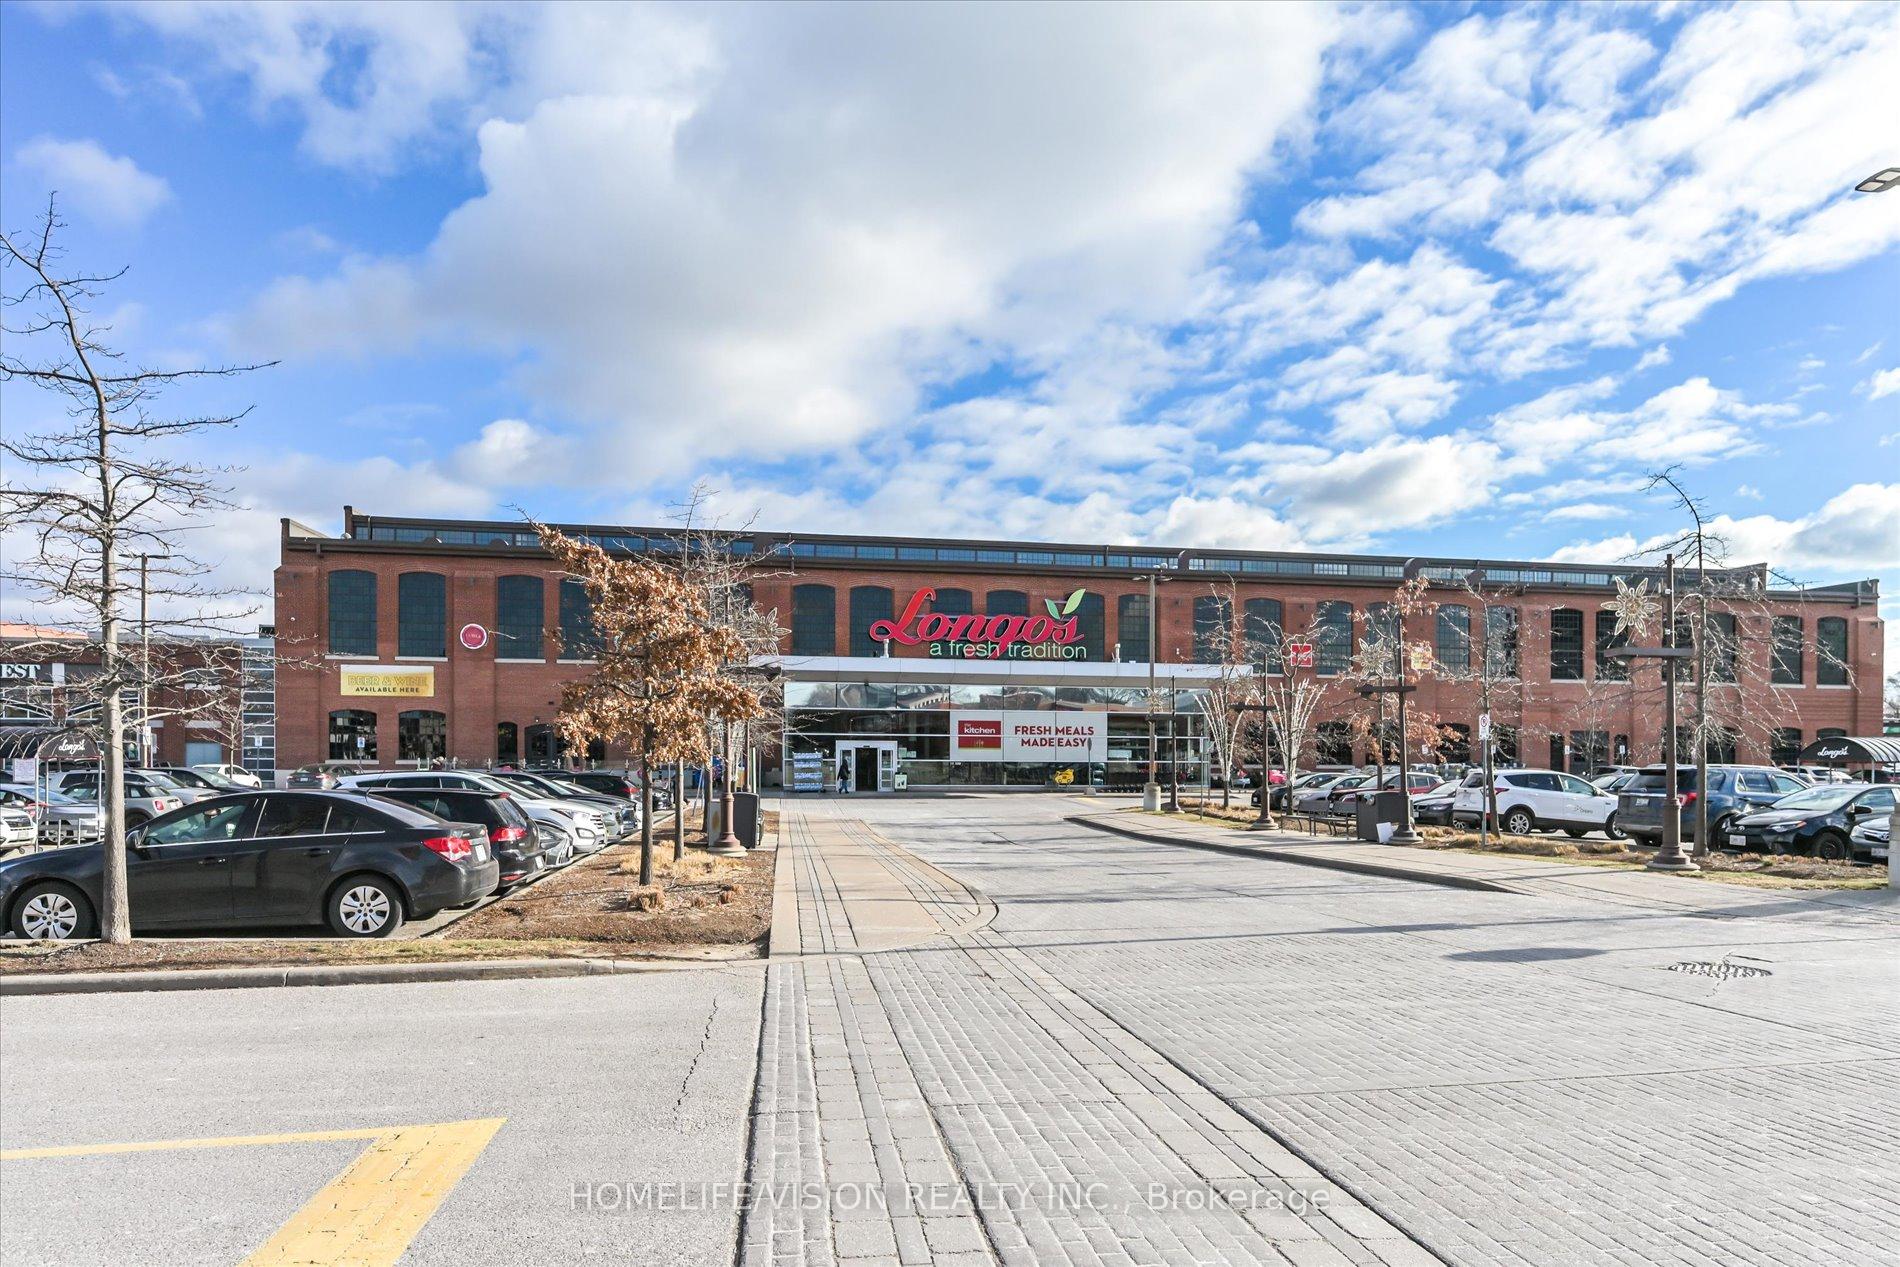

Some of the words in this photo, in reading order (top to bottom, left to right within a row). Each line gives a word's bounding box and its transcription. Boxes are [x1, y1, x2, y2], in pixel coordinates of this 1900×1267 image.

[929, 643, 942, 656] a
[950, 640, 999, 658] fresh
[1007, 641, 1087, 659] tradition
[348, 675, 380, 687] BEER
[382, 675, 392, 687] &
[394, 676, 428, 688] WINE
[963, 726, 996, 735] kitchen
[1014, 725, 1052, 736] FRESH
[1055, 726, 1095, 736] MEALS
[1021, 737, 1055, 747] MADE
[1057, 738, 1087, 748] EASY
